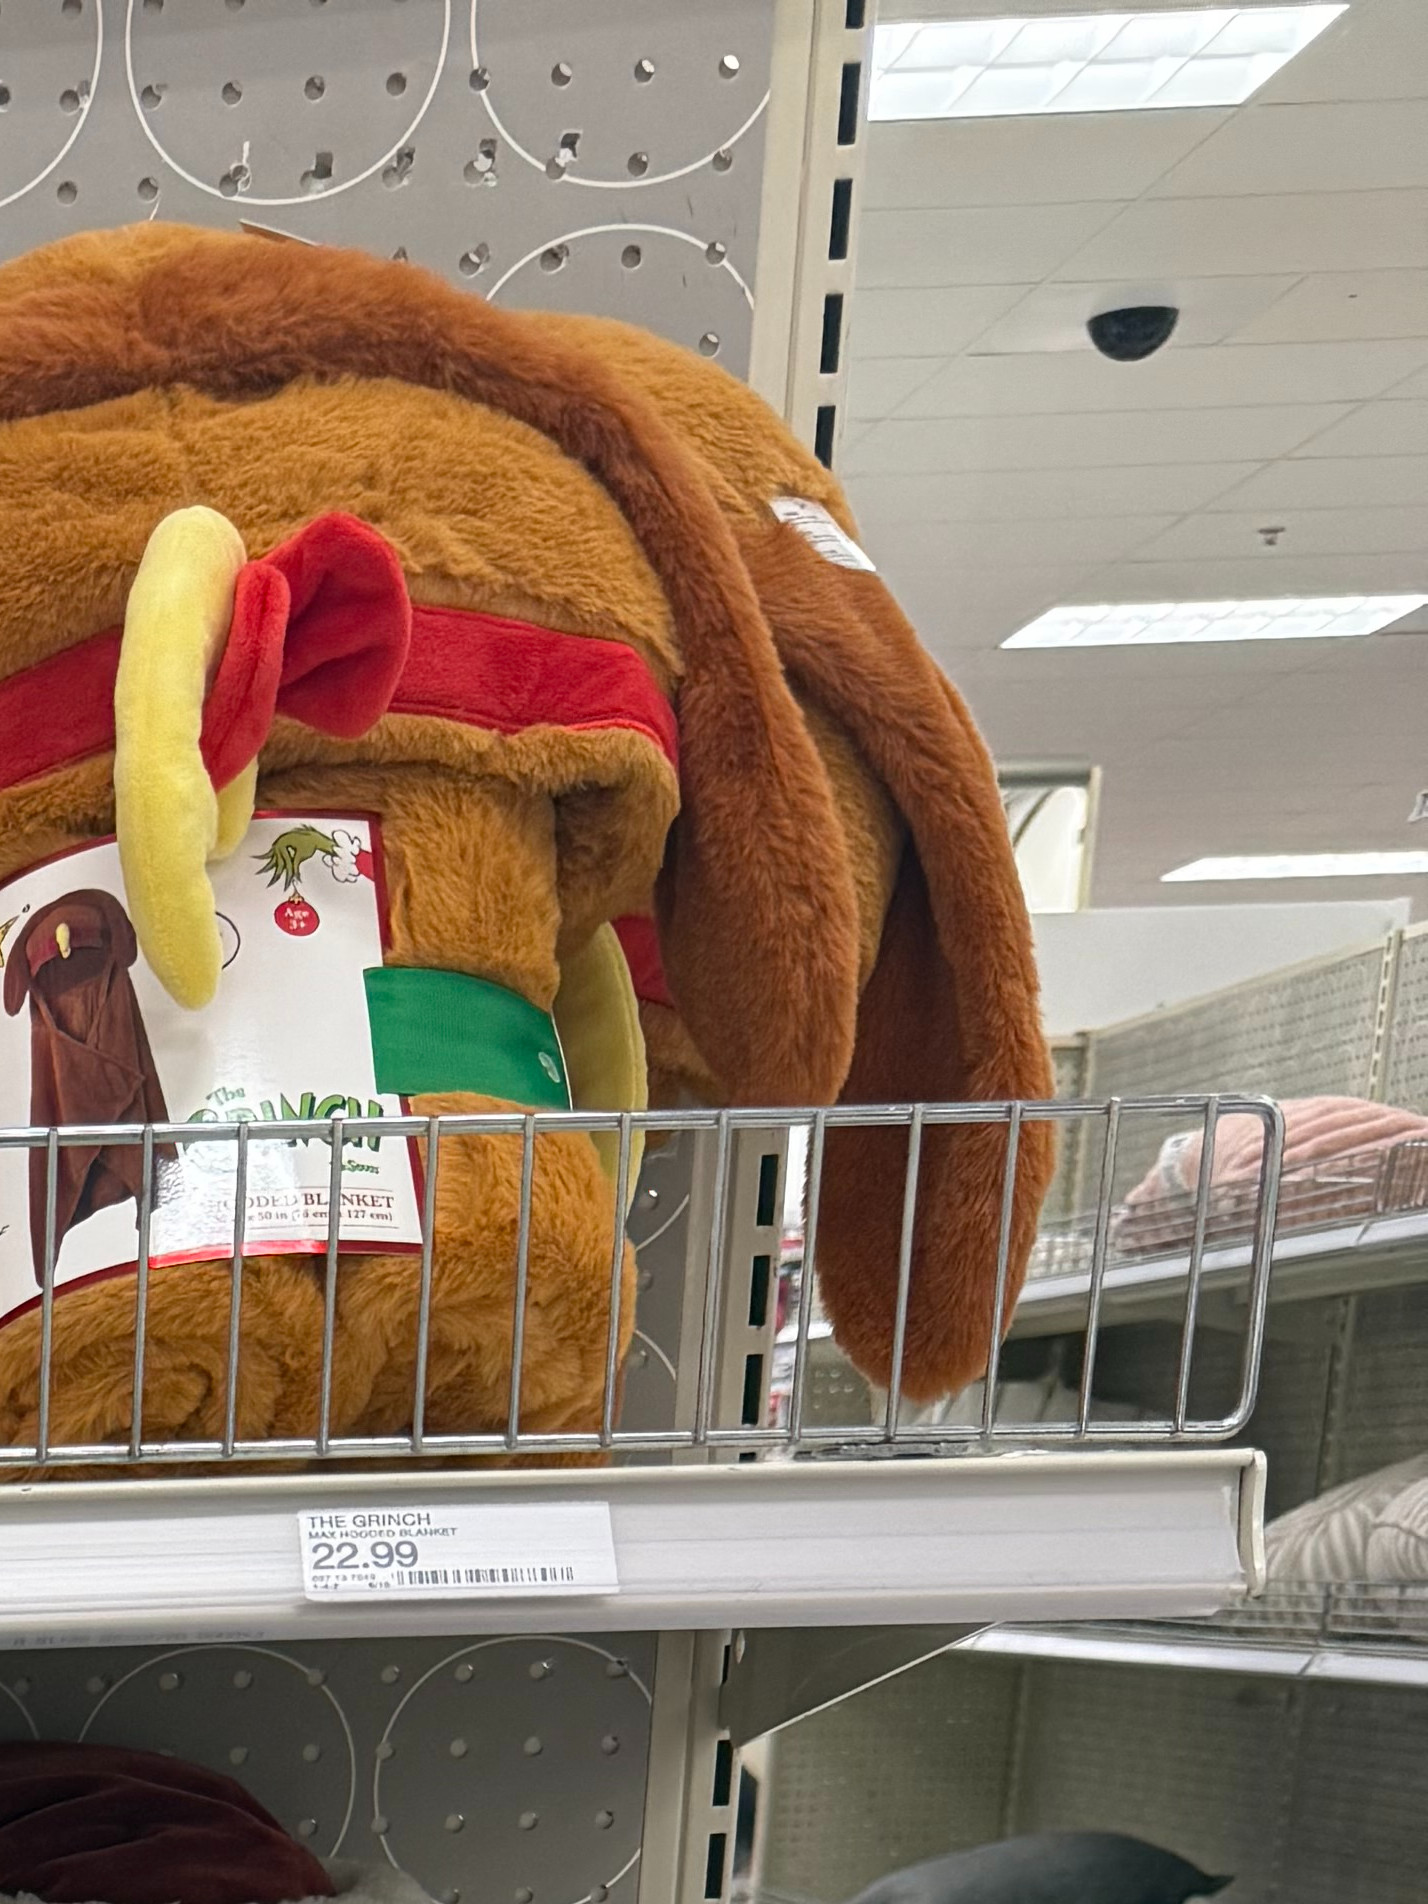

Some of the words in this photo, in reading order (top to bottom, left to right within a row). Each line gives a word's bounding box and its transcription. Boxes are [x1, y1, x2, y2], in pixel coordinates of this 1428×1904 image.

[206, 1087, 245, 1105] The
[307, 1516, 346, 1528] THE
[352, 1512, 431, 1527] GRINCH
[308, 1530, 335, 1539] MAX
[340, 1530, 395, 1538] HOODED
[399, 1527, 458, 1537] BLANKET
[311, 1541, 419, 1570] 22.99
